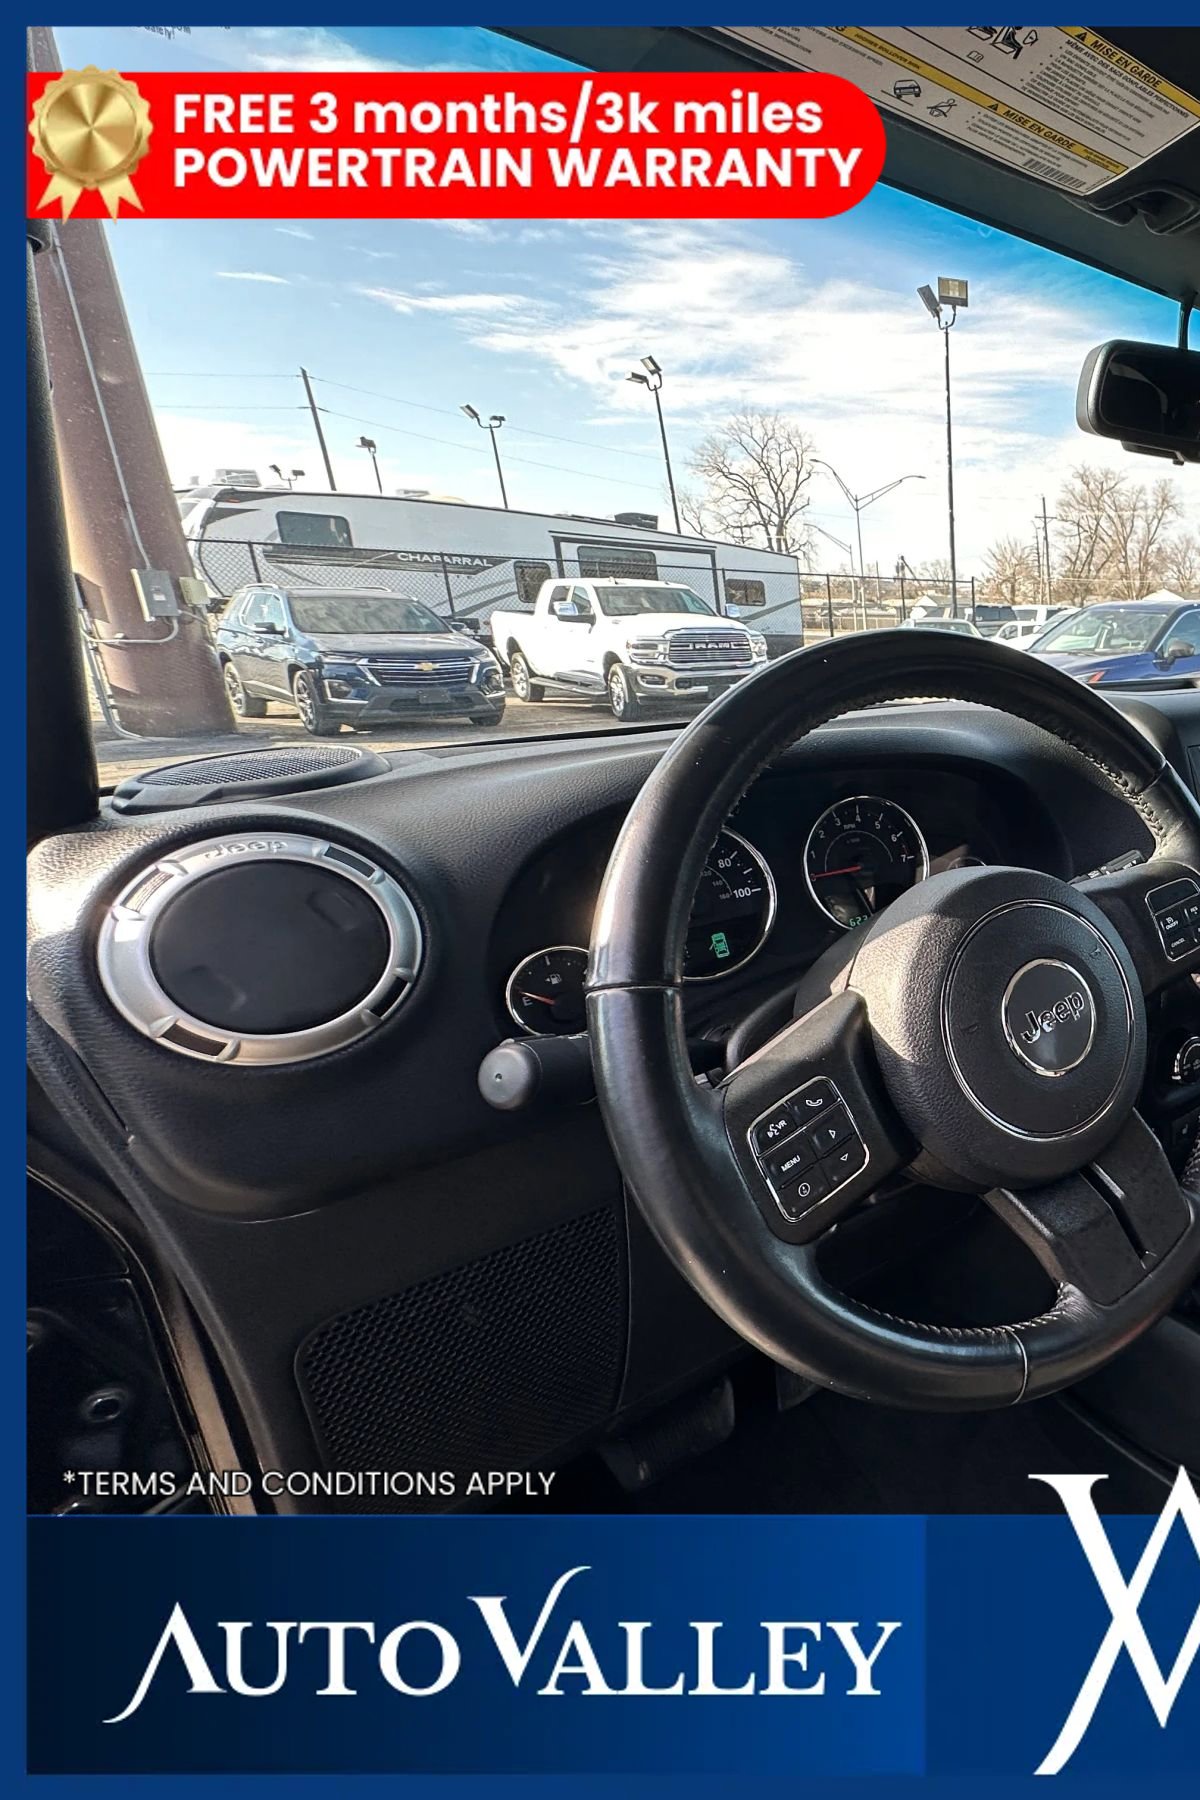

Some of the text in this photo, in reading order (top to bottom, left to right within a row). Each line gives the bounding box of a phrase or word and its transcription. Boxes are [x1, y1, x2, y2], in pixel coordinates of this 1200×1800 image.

[1089, 40, 1162, 87] MISE EN GARDE
[1002, 109, 1076, 149] MISE EN GARDE
[397, 552, 493, 567] CHAPARRAL
[835, 818, 841, 826] 3
[855, 814, 861, 822] 4
[874, 821, 881, 829] 5
[819, 830, 826, 839] 2
[891, 834, 898, 842] 6
[204, 841, 288, 859] Jeep
[717, 857, 732, 869] 80
[901, 854, 907, 862] 7
[733, 886, 752, 899] 100
[522, 996, 533, 1007] E
[1020, 992, 1085, 1044] Jeep
[774, 1119, 788, 1130] VR
[781, 1154, 801, 1172] MENU
